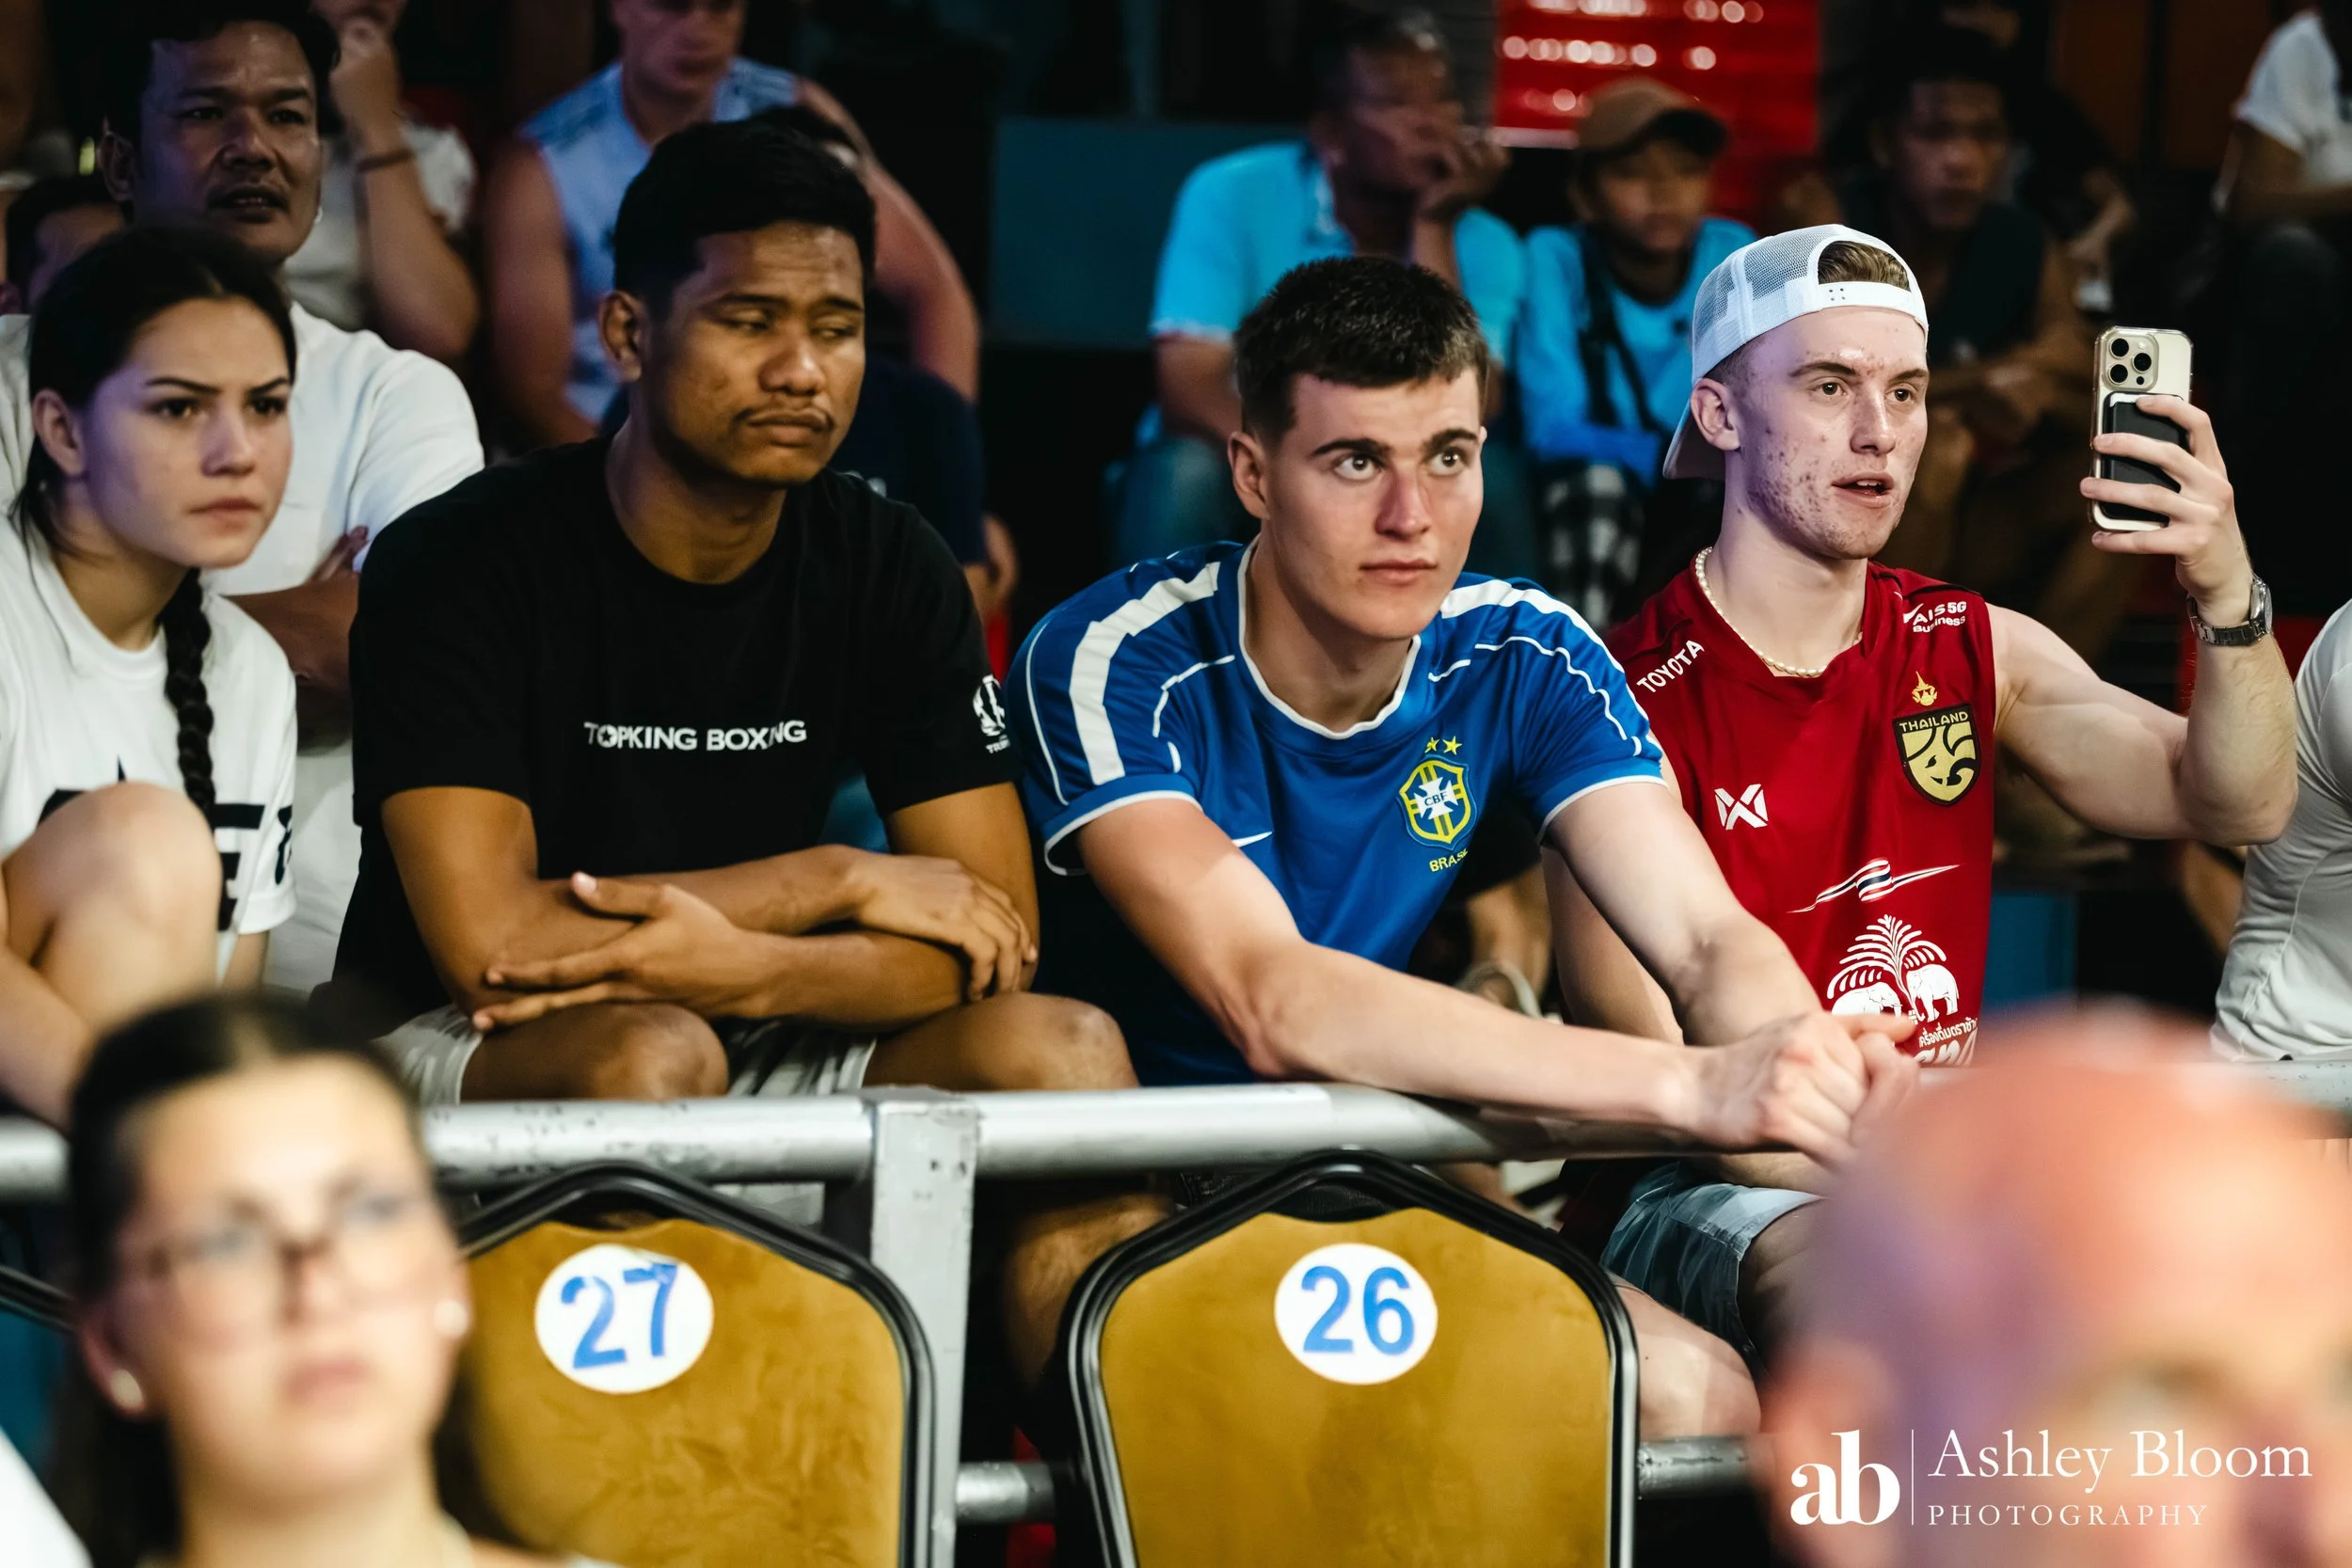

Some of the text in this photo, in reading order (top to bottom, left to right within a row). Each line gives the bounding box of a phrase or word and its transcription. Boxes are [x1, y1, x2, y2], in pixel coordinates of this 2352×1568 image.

[1913, 601, 1967, 626] AIS 5G
[1636, 640, 1705, 693] TOYOTA
[583, 721, 698, 751] TOPKING
[1899, 711, 1968, 732] THAILAND
[1424, 791, 1448, 806] CBF
[561, 1262, 678, 1370] 27
[1301, 1265, 1415, 1356] 26
